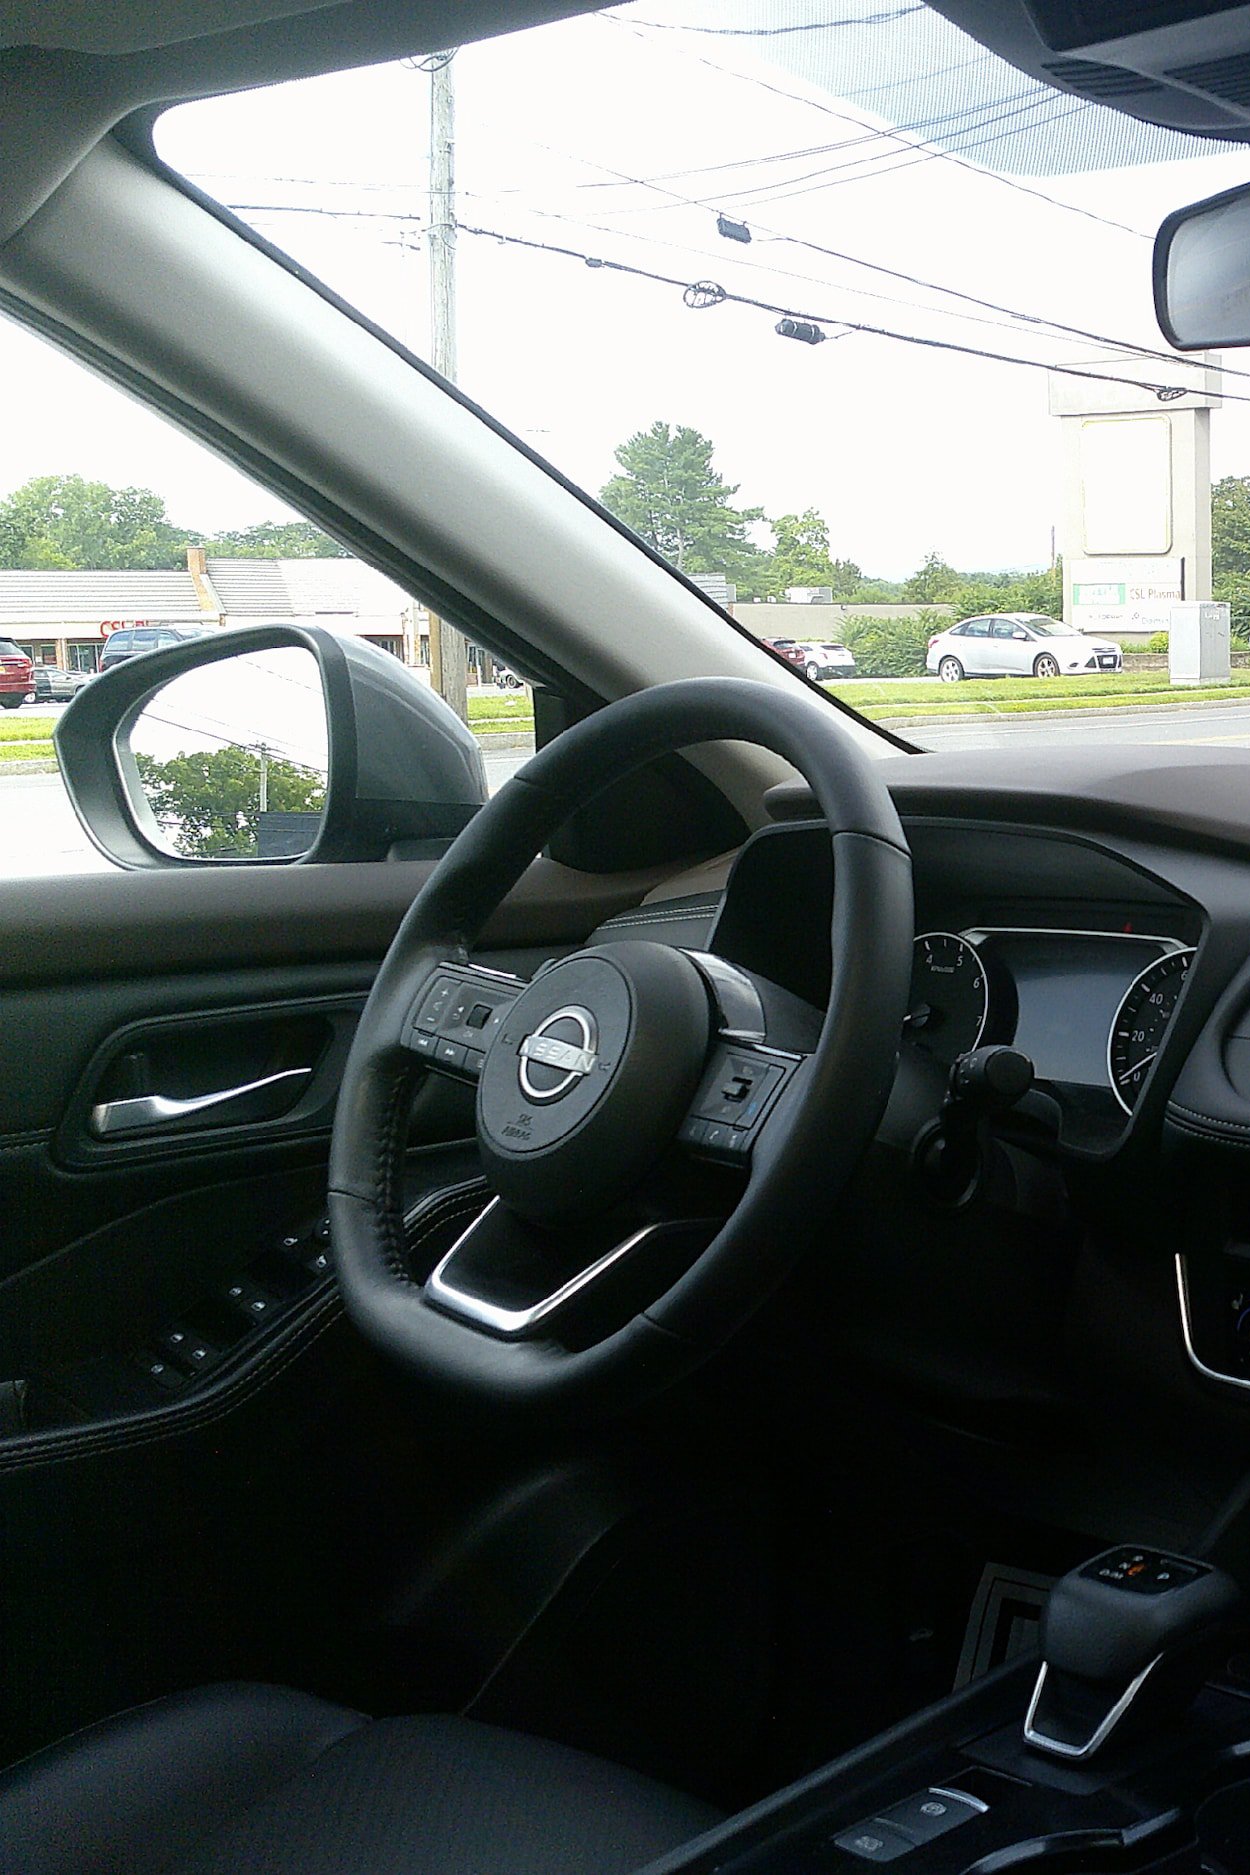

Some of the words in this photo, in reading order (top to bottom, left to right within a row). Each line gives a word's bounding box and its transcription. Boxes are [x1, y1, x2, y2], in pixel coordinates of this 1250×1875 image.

[1130, 588, 1145, 599] CSL
[1148, 588, 1181, 600] Plasma
[925, 954, 933, 964] 4
[956, 955, 964, 966] 5
[973, 977, 980, 989] 6
[1149, 992, 1164, 1006] 40
[1131, 1030, 1145, 1042] 20
